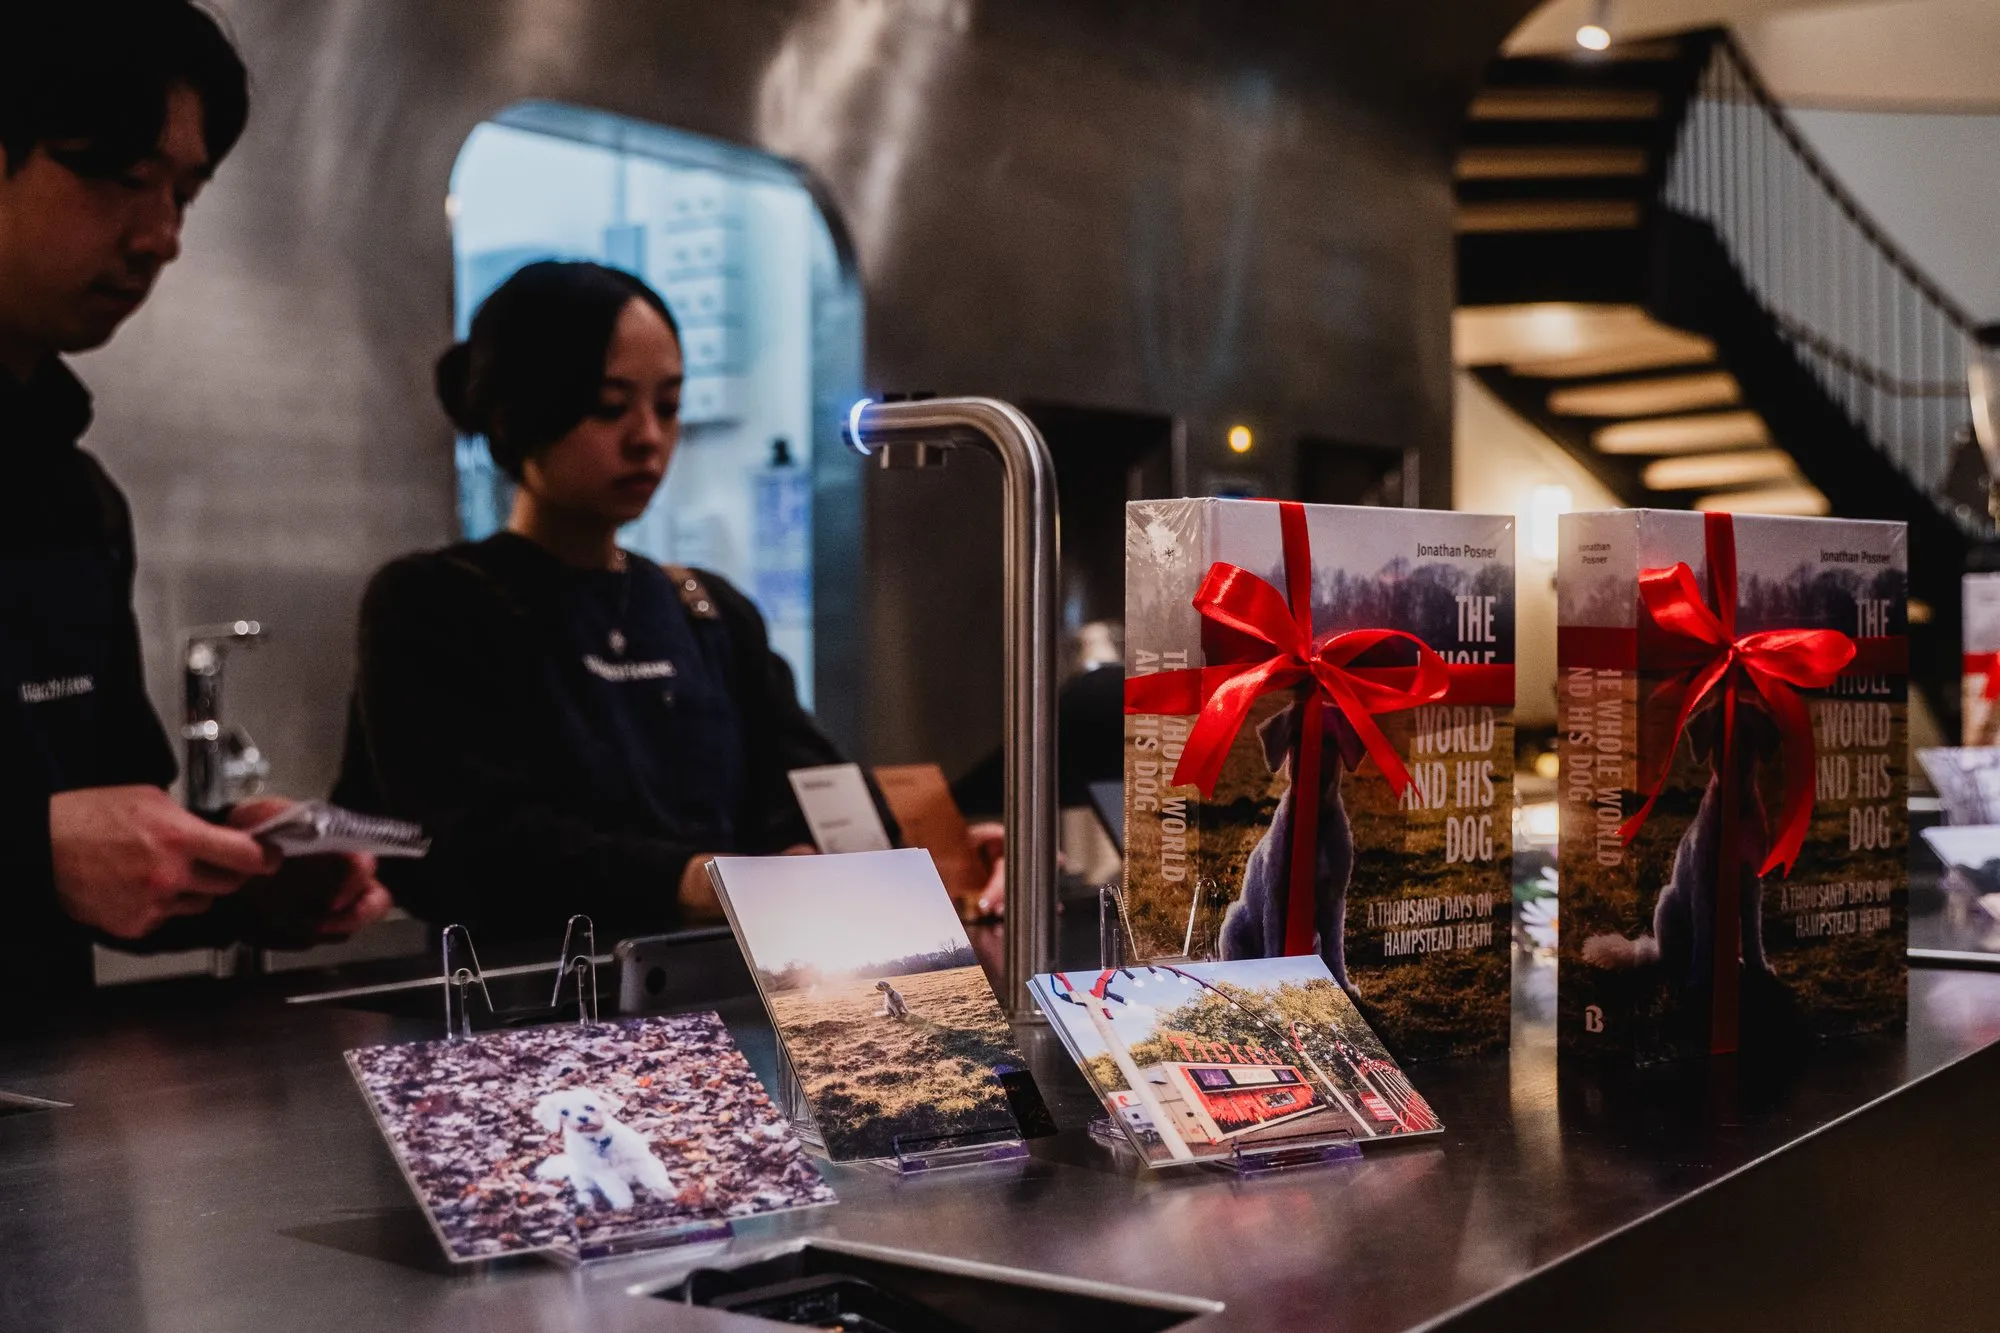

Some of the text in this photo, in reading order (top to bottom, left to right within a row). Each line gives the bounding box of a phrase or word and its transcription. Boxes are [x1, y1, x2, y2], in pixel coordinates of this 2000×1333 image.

[1417, 543, 1497, 559] Jonathan Posner
[1820, 550, 1891, 564] Jonathan Posner
[1455, 595, 1497, 642] THE
[1135, 649, 1160, 676] AN
[1414, 704, 1495, 754] WORLD
[1568, 667, 1593, 803] ND HIS DOG
[1597, 699, 1623, 779] WHOLE
[1820, 702, 1891, 747] WORLD
[1134, 760, 1159, 812] DOG
[1456, 760, 1494, 808] HIS
[1815, 754, 1891, 800] ND HIS
[1160, 796, 1187, 882] WORLD
[1446, 815, 1493, 864] DOG
[1597, 787, 1623, 867] WORLD
[1850, 806, 1891, 850] DOG
[1367, 892, 1493, 928] A THOUSAND DAYS ON
[1780, 879, 1891, 911] A THOUSAND DAYS ON
[1384, 922, 1493, 957] HAMPSTEAD HEATH
[1796, 907, 1891, 938] HAMPSTEAD HEATH
[1585, 1004, 1605, 1033] B
[1167, 1035, 1284, 1065] TICKETS
